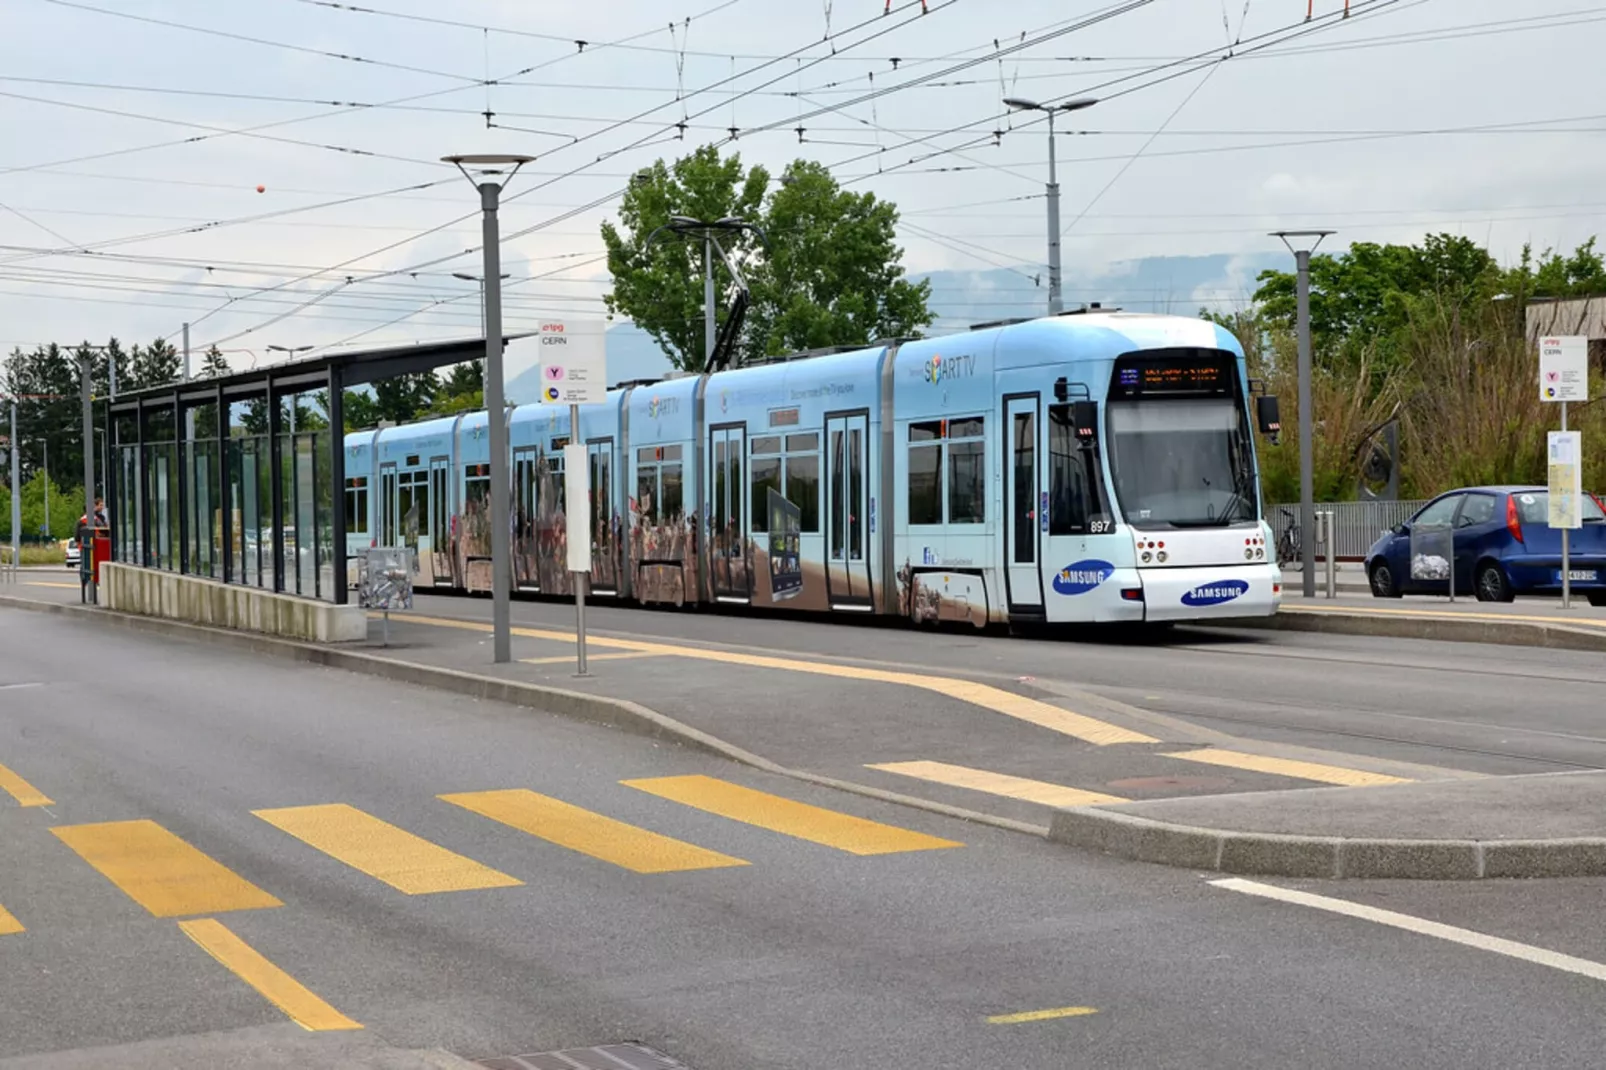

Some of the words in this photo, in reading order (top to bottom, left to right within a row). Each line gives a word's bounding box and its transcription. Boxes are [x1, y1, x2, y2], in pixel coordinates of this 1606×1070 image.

[542, 336, 567, 345] CERN
[551, 368, 559, 378] Y
[1549, 372, 1556, 380] Y
[1091, 521, 1110, 533] 897
[1190, 588, 1241, 599] SAMSUNG
